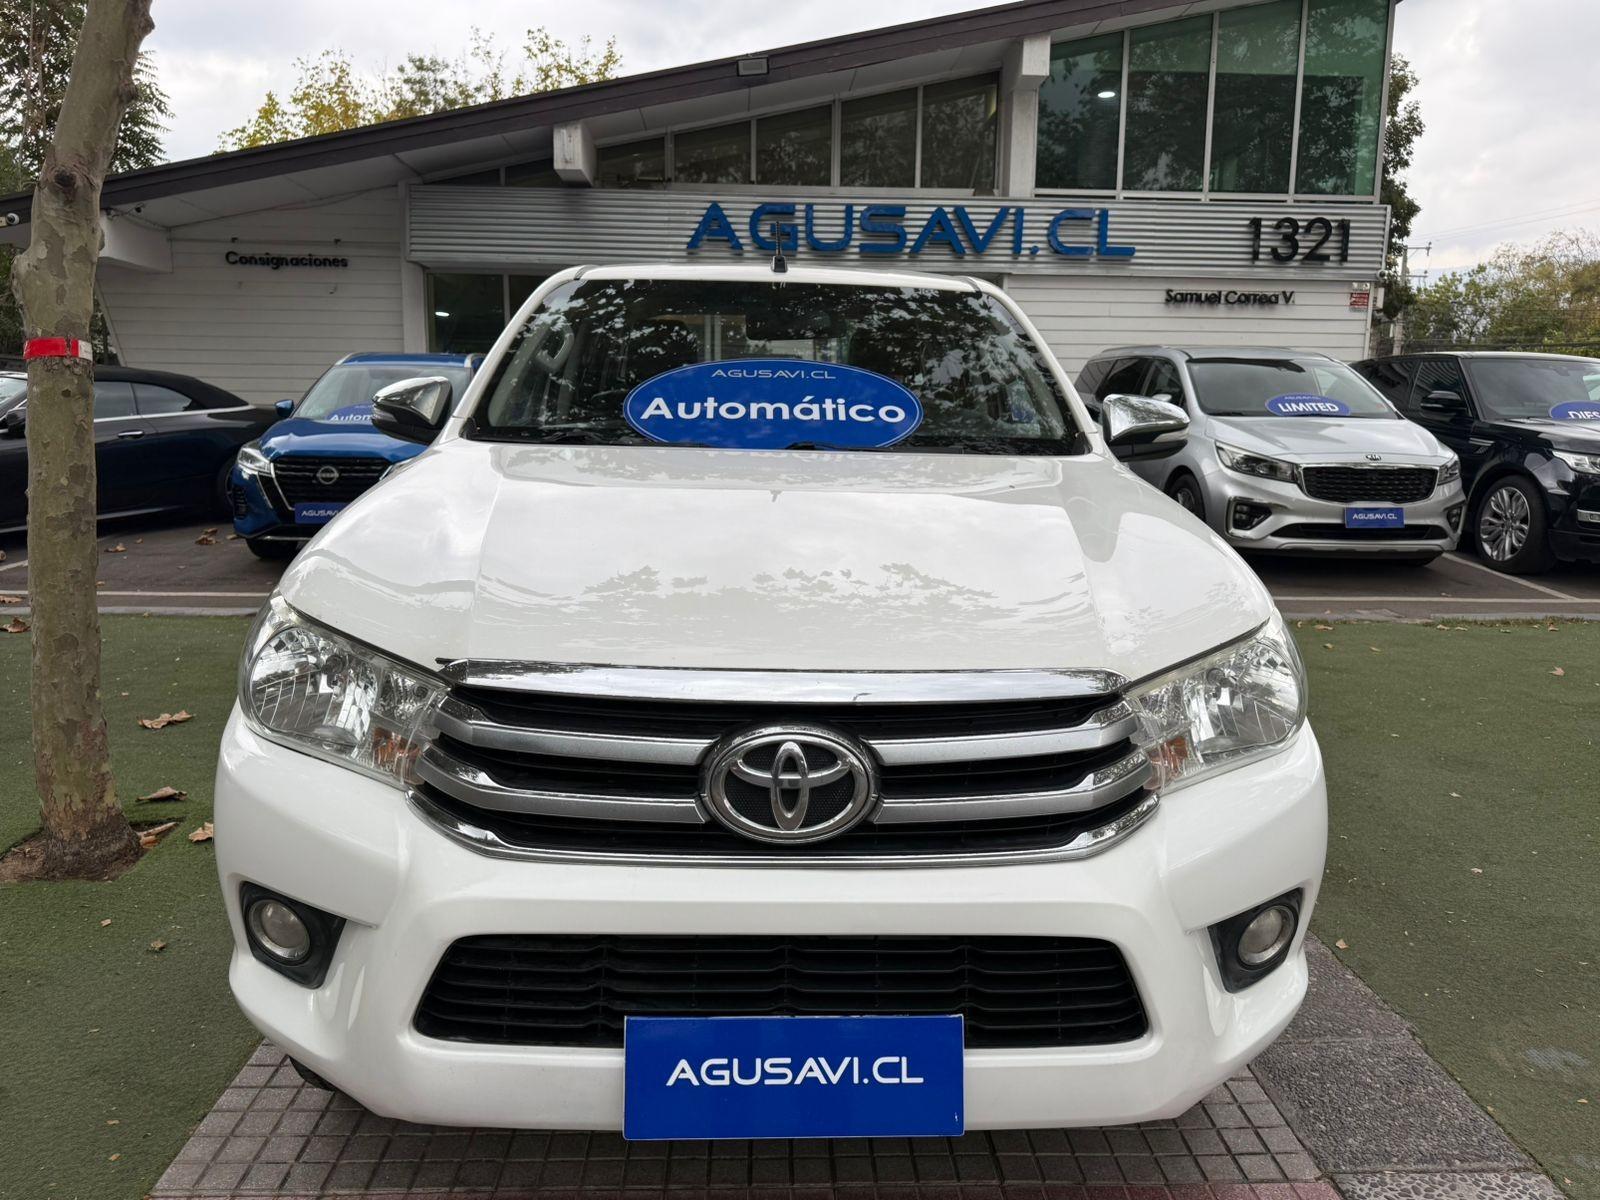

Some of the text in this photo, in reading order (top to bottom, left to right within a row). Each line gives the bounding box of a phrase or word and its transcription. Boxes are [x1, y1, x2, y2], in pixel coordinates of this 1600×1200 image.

[686, 201, 1136, 257] AGUSAVI.CL
[1247, 216, 1350, 263] 1321
[225, 251, 348, 270] Consignaciones
[1165, 289, 1222, 304] Samuel
[1225, 290, 1279, 305] Correa
[711, 369, 836, 379] AGUSAVI.CL
[640, 395, 906, 423] Automático
[1278, 402, 1340, 413] LIMITED
[665, 1056, 924, 1086] AGUSAVI.CL
